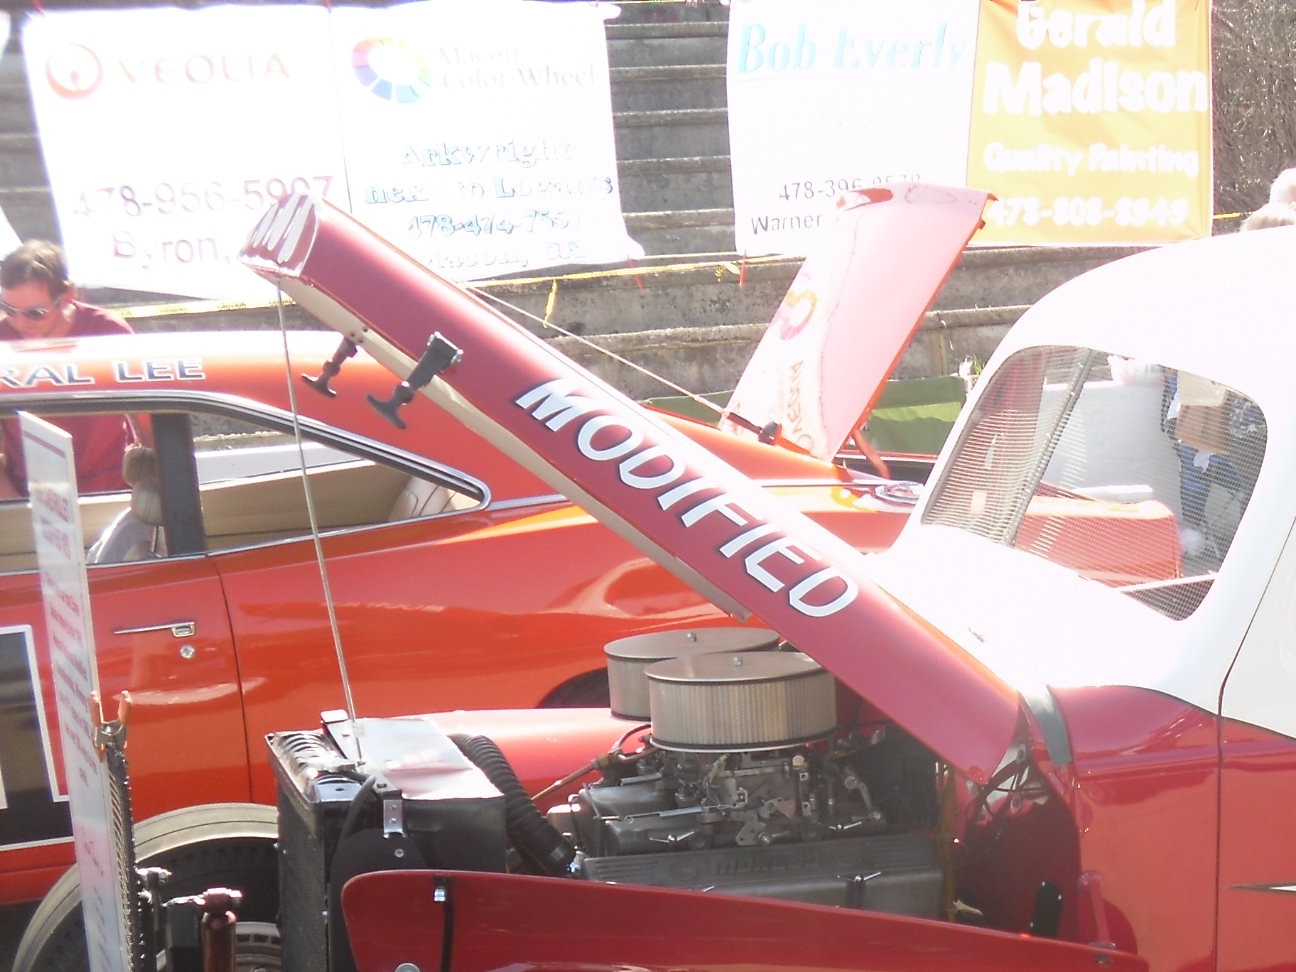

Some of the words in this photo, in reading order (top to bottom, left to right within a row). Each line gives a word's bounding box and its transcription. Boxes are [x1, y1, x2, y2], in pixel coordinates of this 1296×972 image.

[736, 21, 817, 76] Bob
[832, 22, 968, 73] Everly
[1016, 0, 1177, 50] Gerald
[118, 53, 290, 84] VEOLIA
[983, 56, 1209, 116] Madison
[751, 212, 824, 235] Warner
[111, 357, 206, 384] LEE
[514, 377, 860, 618] MODIFIED
